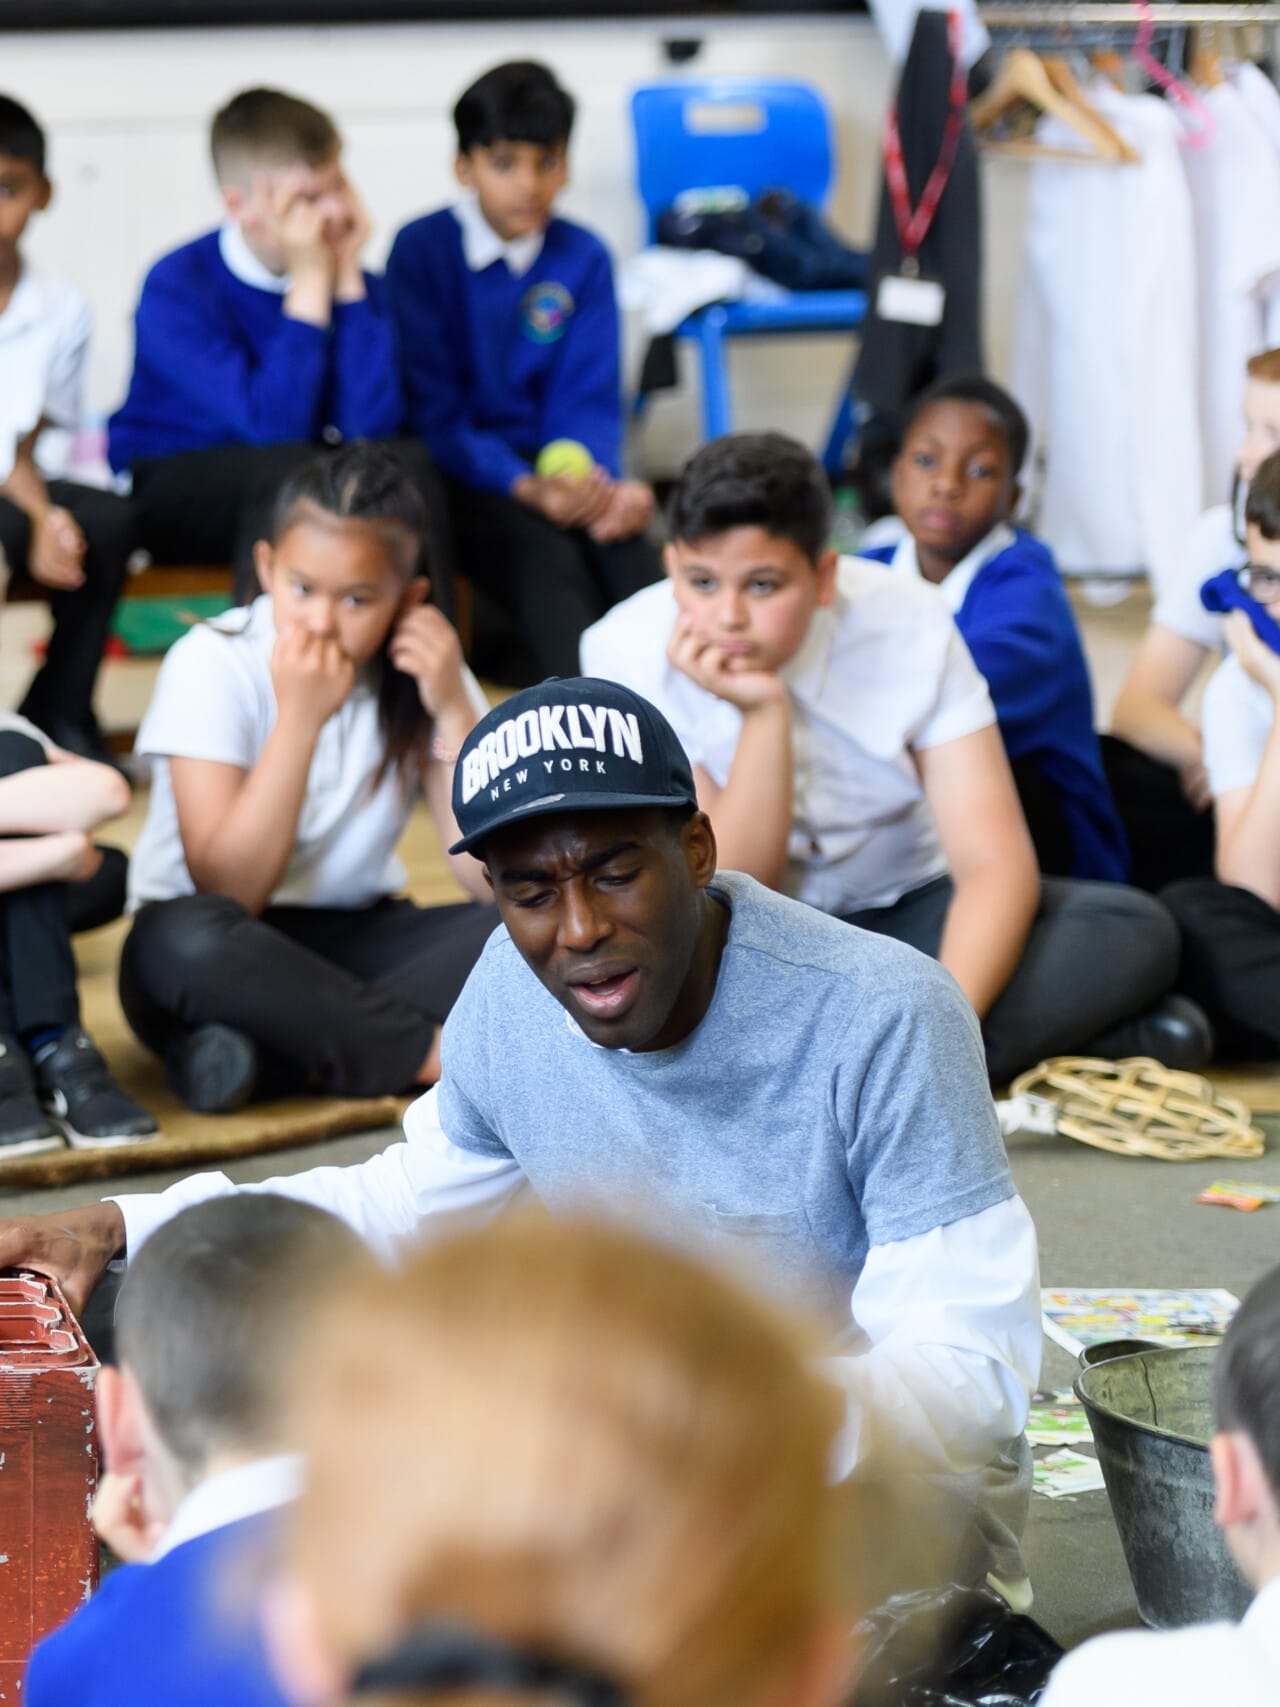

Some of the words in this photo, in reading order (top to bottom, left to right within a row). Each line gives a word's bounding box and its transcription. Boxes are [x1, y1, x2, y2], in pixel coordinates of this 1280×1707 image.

[461, 704, 643, 804] BROOKLYN
[491, 768, 528, 801] NEW
[543, 758, 607, 776] YORK
